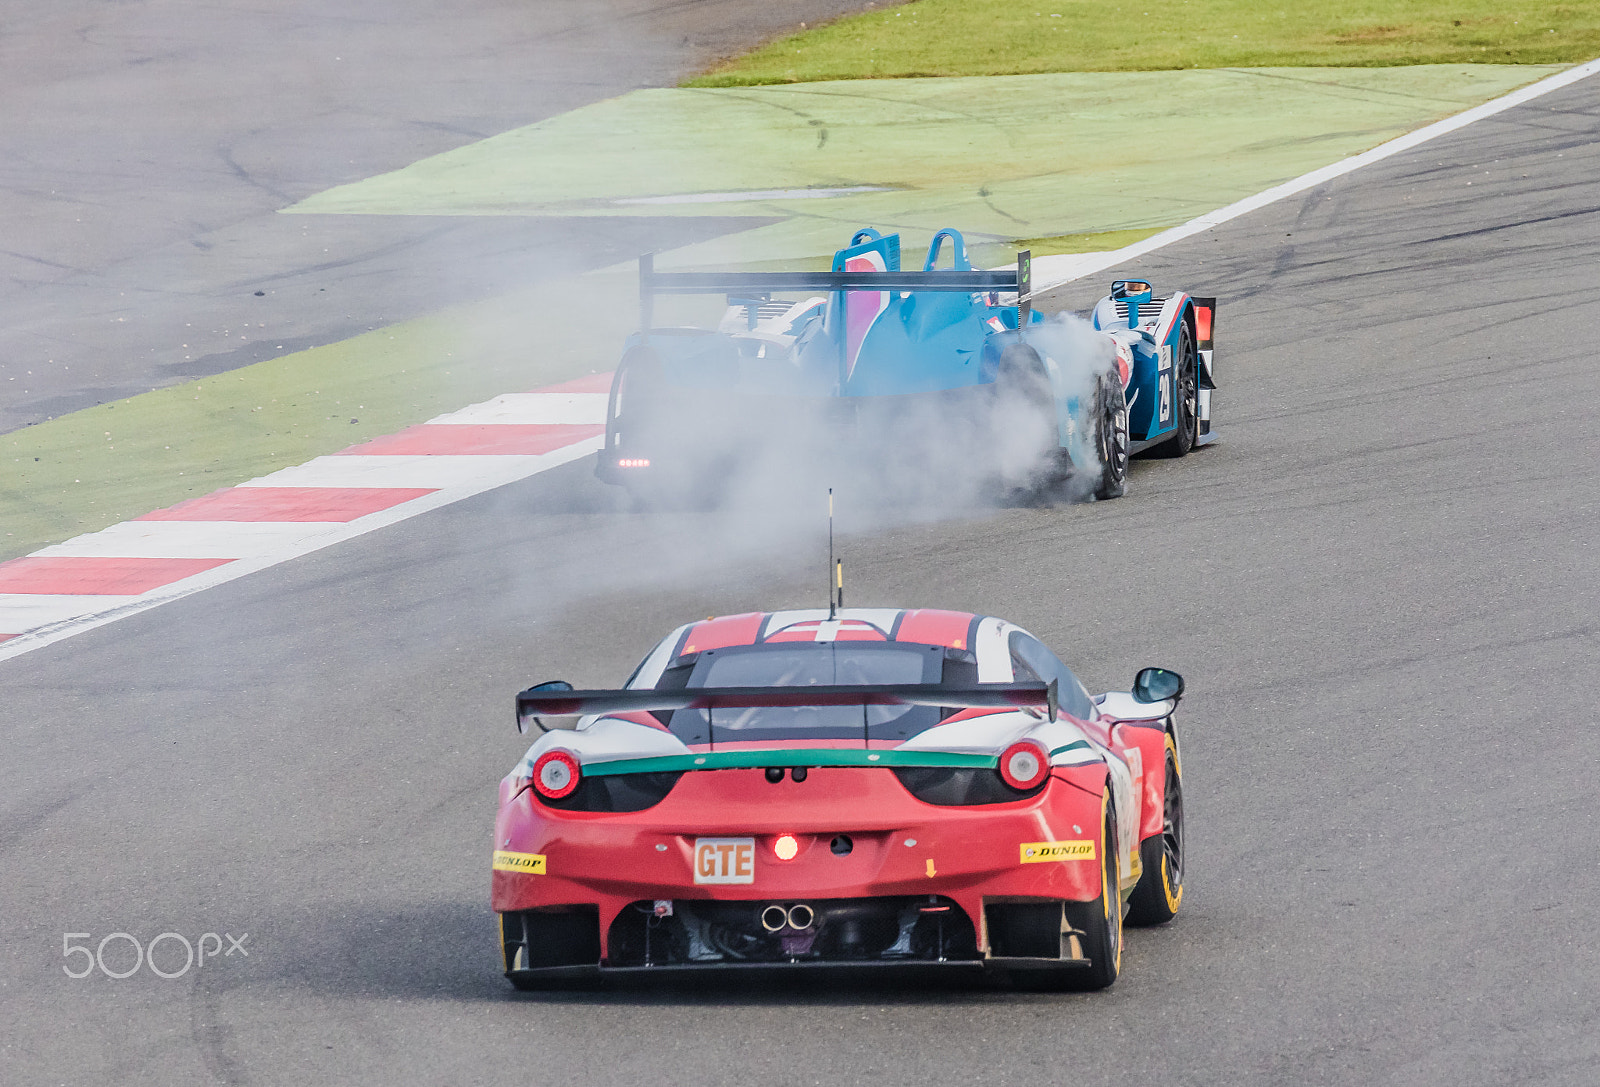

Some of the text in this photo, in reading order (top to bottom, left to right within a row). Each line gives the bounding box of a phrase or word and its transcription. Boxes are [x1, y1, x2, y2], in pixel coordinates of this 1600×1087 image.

[1159, 373, 1170, 423] 29
[697, 844, 752, 877] GTE
[1039, 846, 1092, 856] DUNLOP
